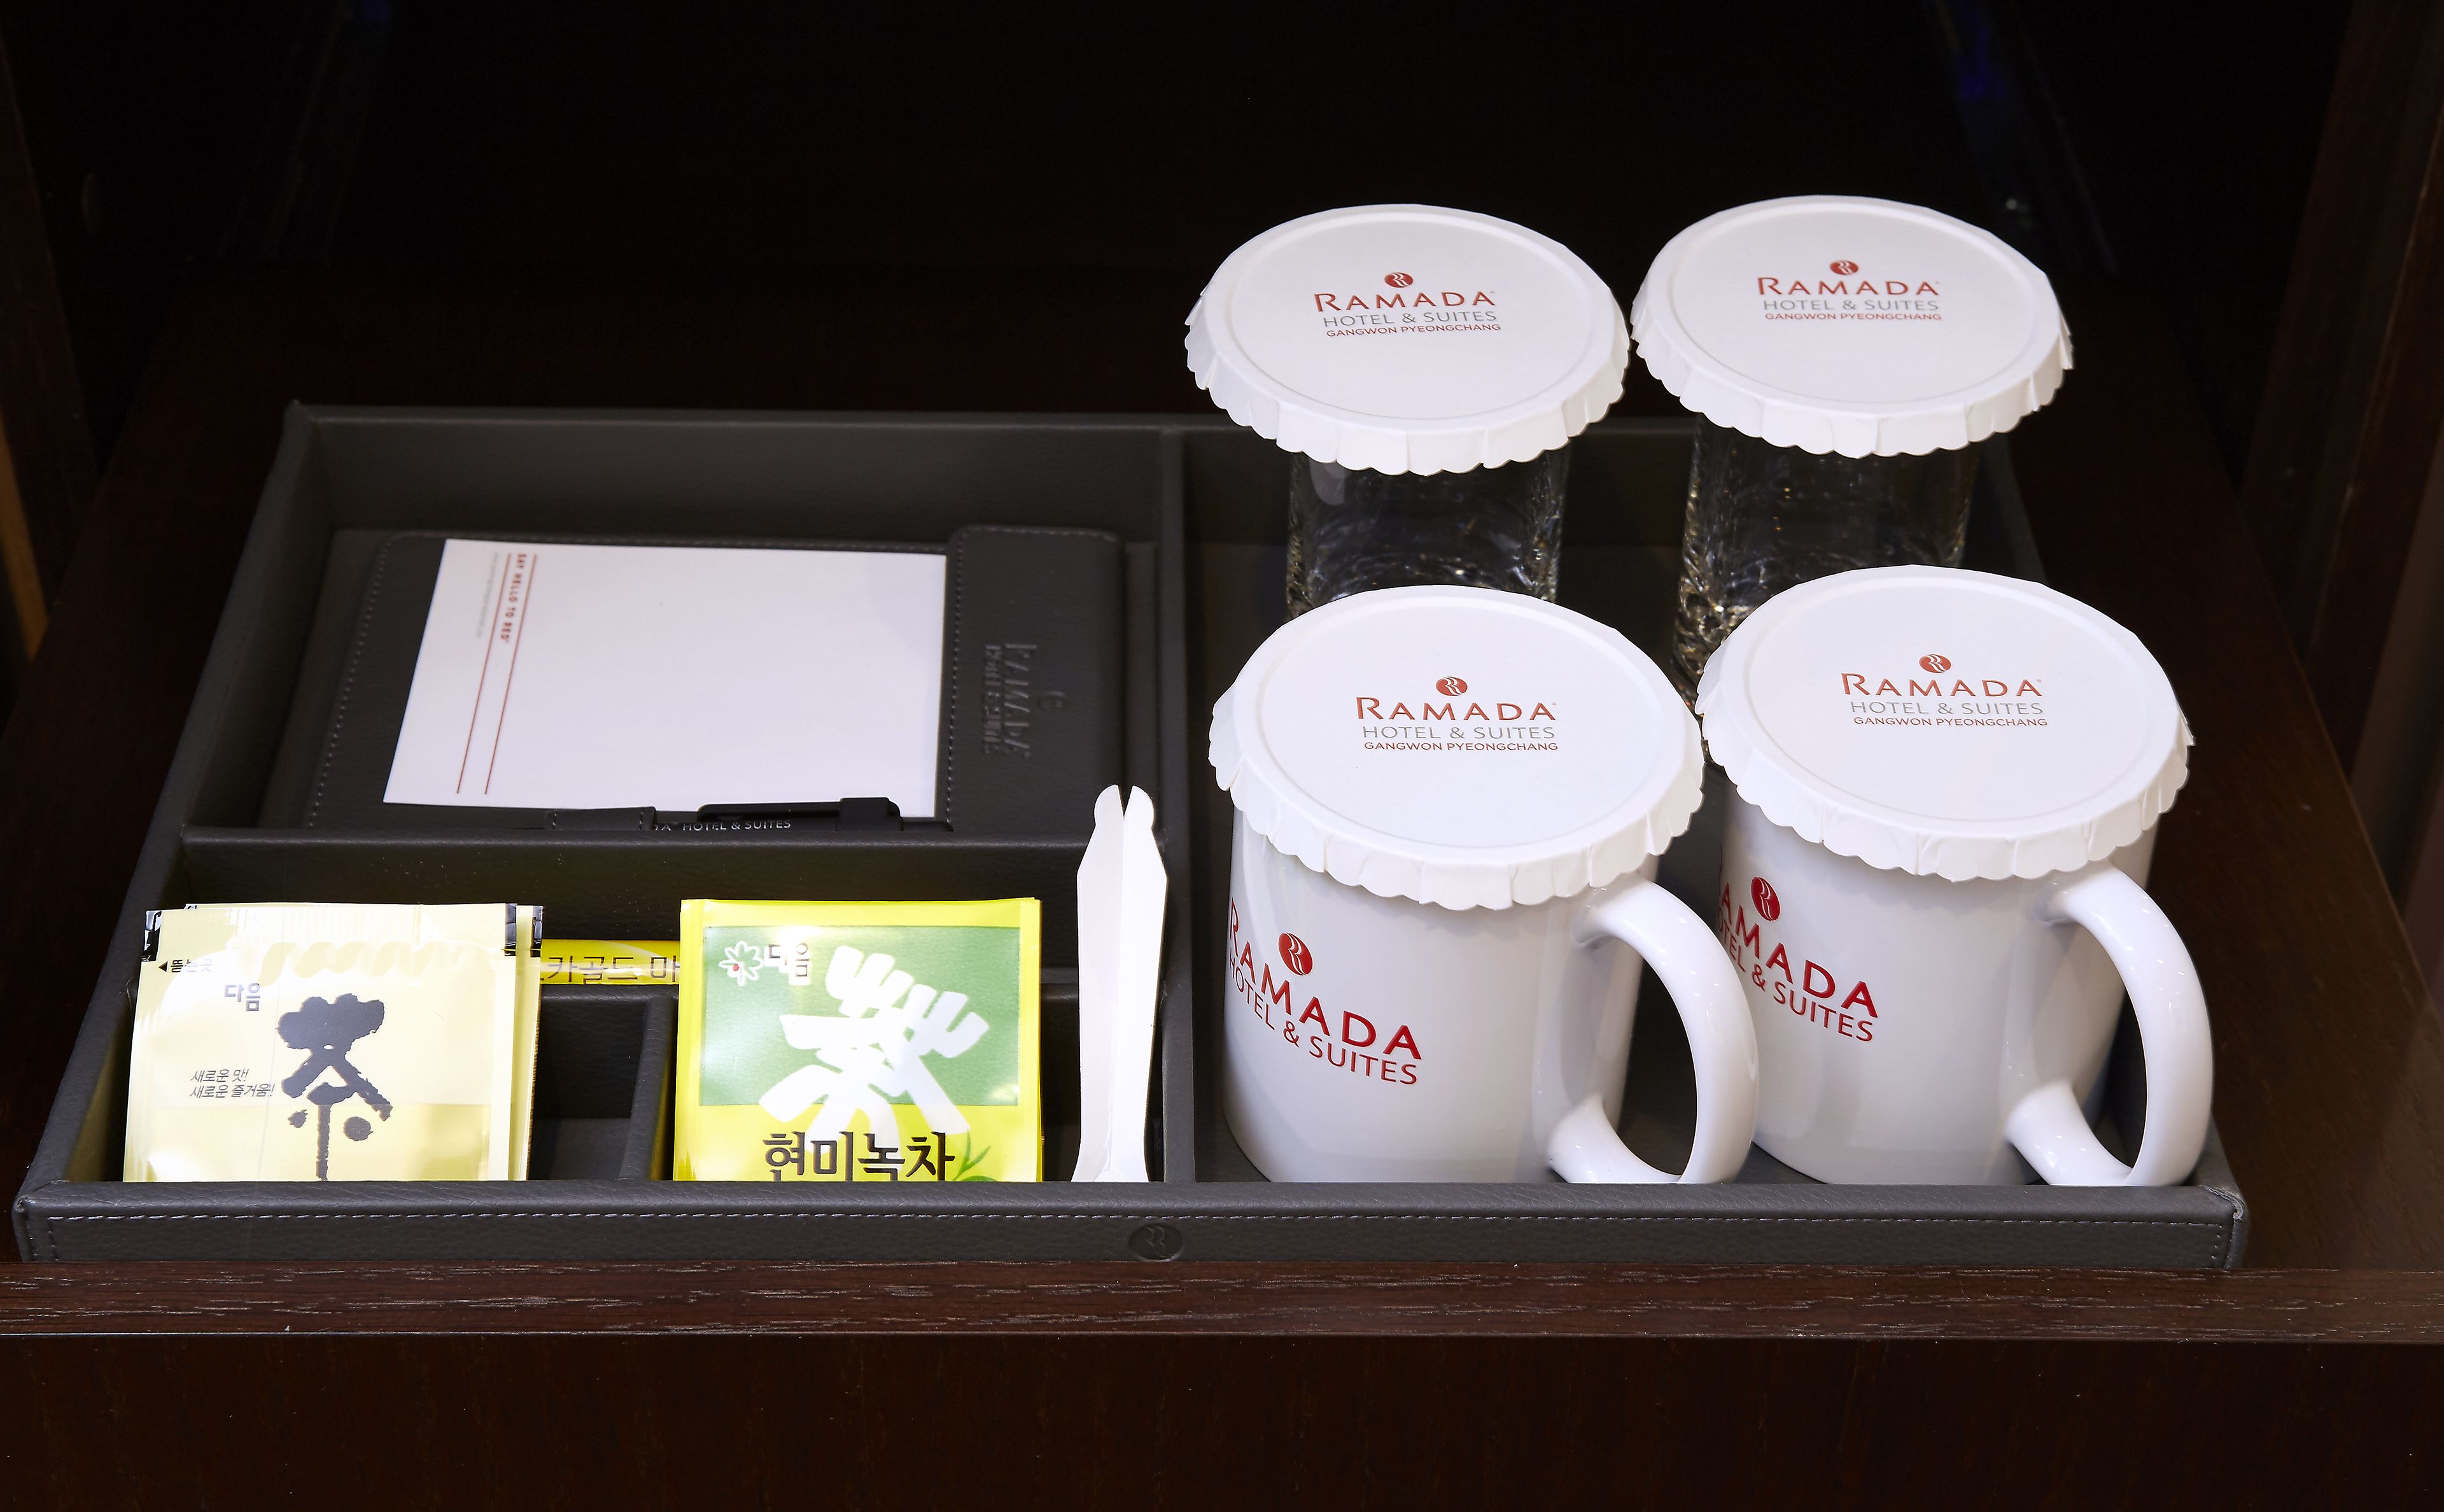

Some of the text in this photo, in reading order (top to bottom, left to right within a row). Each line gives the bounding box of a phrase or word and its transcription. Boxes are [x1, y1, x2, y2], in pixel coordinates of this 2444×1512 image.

[1757, 276, 1939, 295] RAMADA
[1314, 291, 1496, 312] RAMADA
[1764, 300, 1939, 311] HOTEL & SUITES
[1323, 311, 1497, 327] HOTEL & SUITES
[1326, 323, 1501, 337] GANGWON PYEONGCHANG
[1841, 672, 2043, 697] RAMADA
[1356, 696, 1556, 720] RAMADA
[1850, 701, 2044, 715] HOTEL & SUITES
[1853, 716, 2047, 727] GANGWON PYEONGCHANG
[1363, 725, 1555, 739] HOTEL & SUITES
[1364, 741, 1558, 751] GANGWON PYEONGCHANG
[683, 822, 727, 831] HOTEL
[731, 822, 740, 830] &
[745, 820, 792, 829] SUITES
[1718, 845, 1878, 1018] AMADA
[540, 955, 638, 984] 카골드
[1230, 896, 1422, 1060] RAMADA
[1717, 904, 1873, 1042] OTEL & SUITES
[223, 982, 262, 1012] 다음
[1229, 947, 1418, 1085] HOTEL & SUITES
[190, 1068, 249, 1082] 새로운 맛!
[189, 1083, 276, 1099] 새로운 즐거움!
[762, 1131, 956, 1182] 현미녹차
